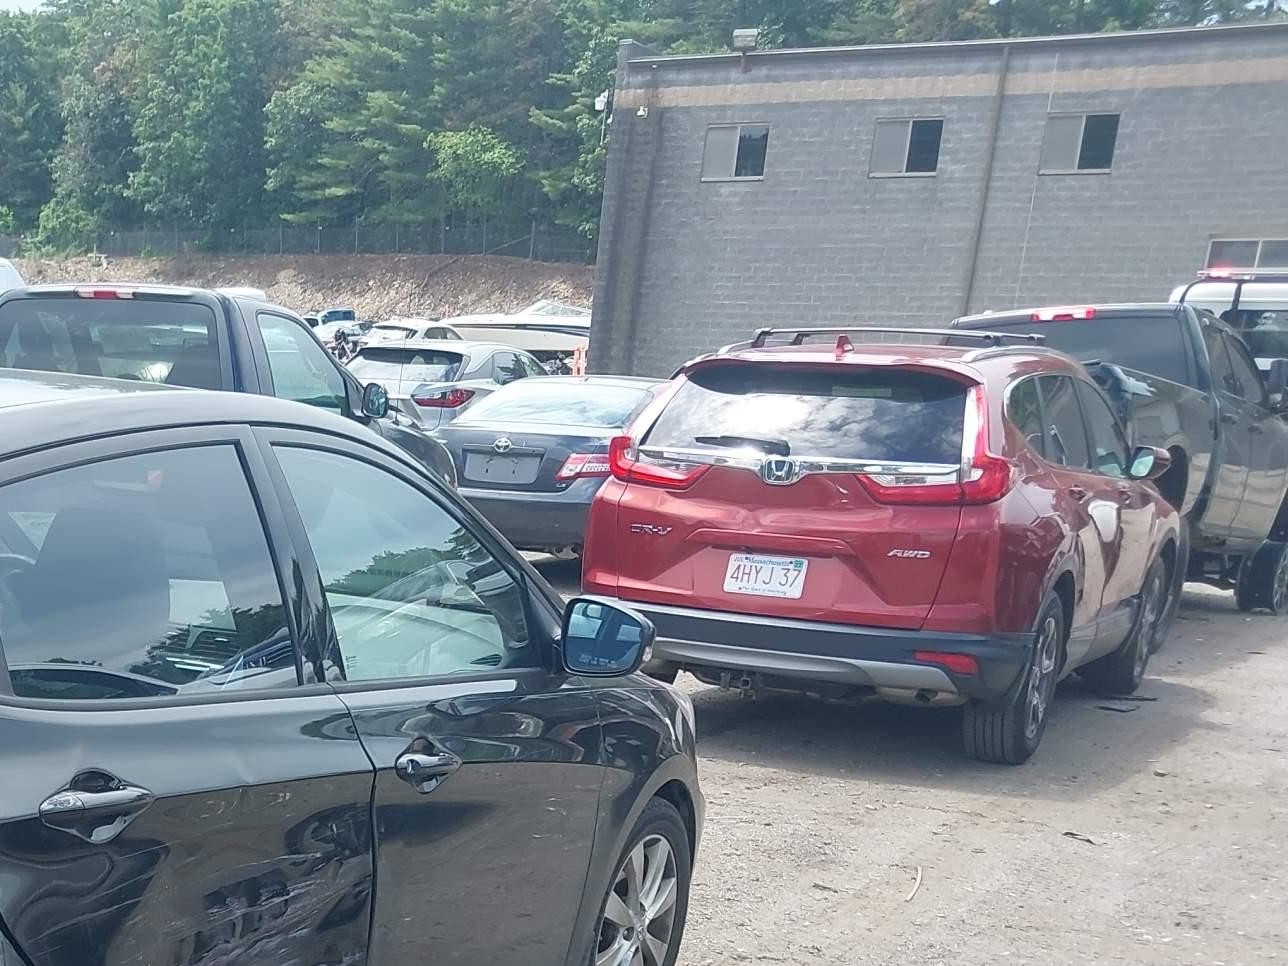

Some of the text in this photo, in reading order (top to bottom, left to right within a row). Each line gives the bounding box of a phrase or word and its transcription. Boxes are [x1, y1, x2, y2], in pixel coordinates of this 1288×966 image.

[631, 523, 673, 535] CR-V
[887, 549, 931, 558] AWD
[730, 563, 802, 588] 4HYJ 37
